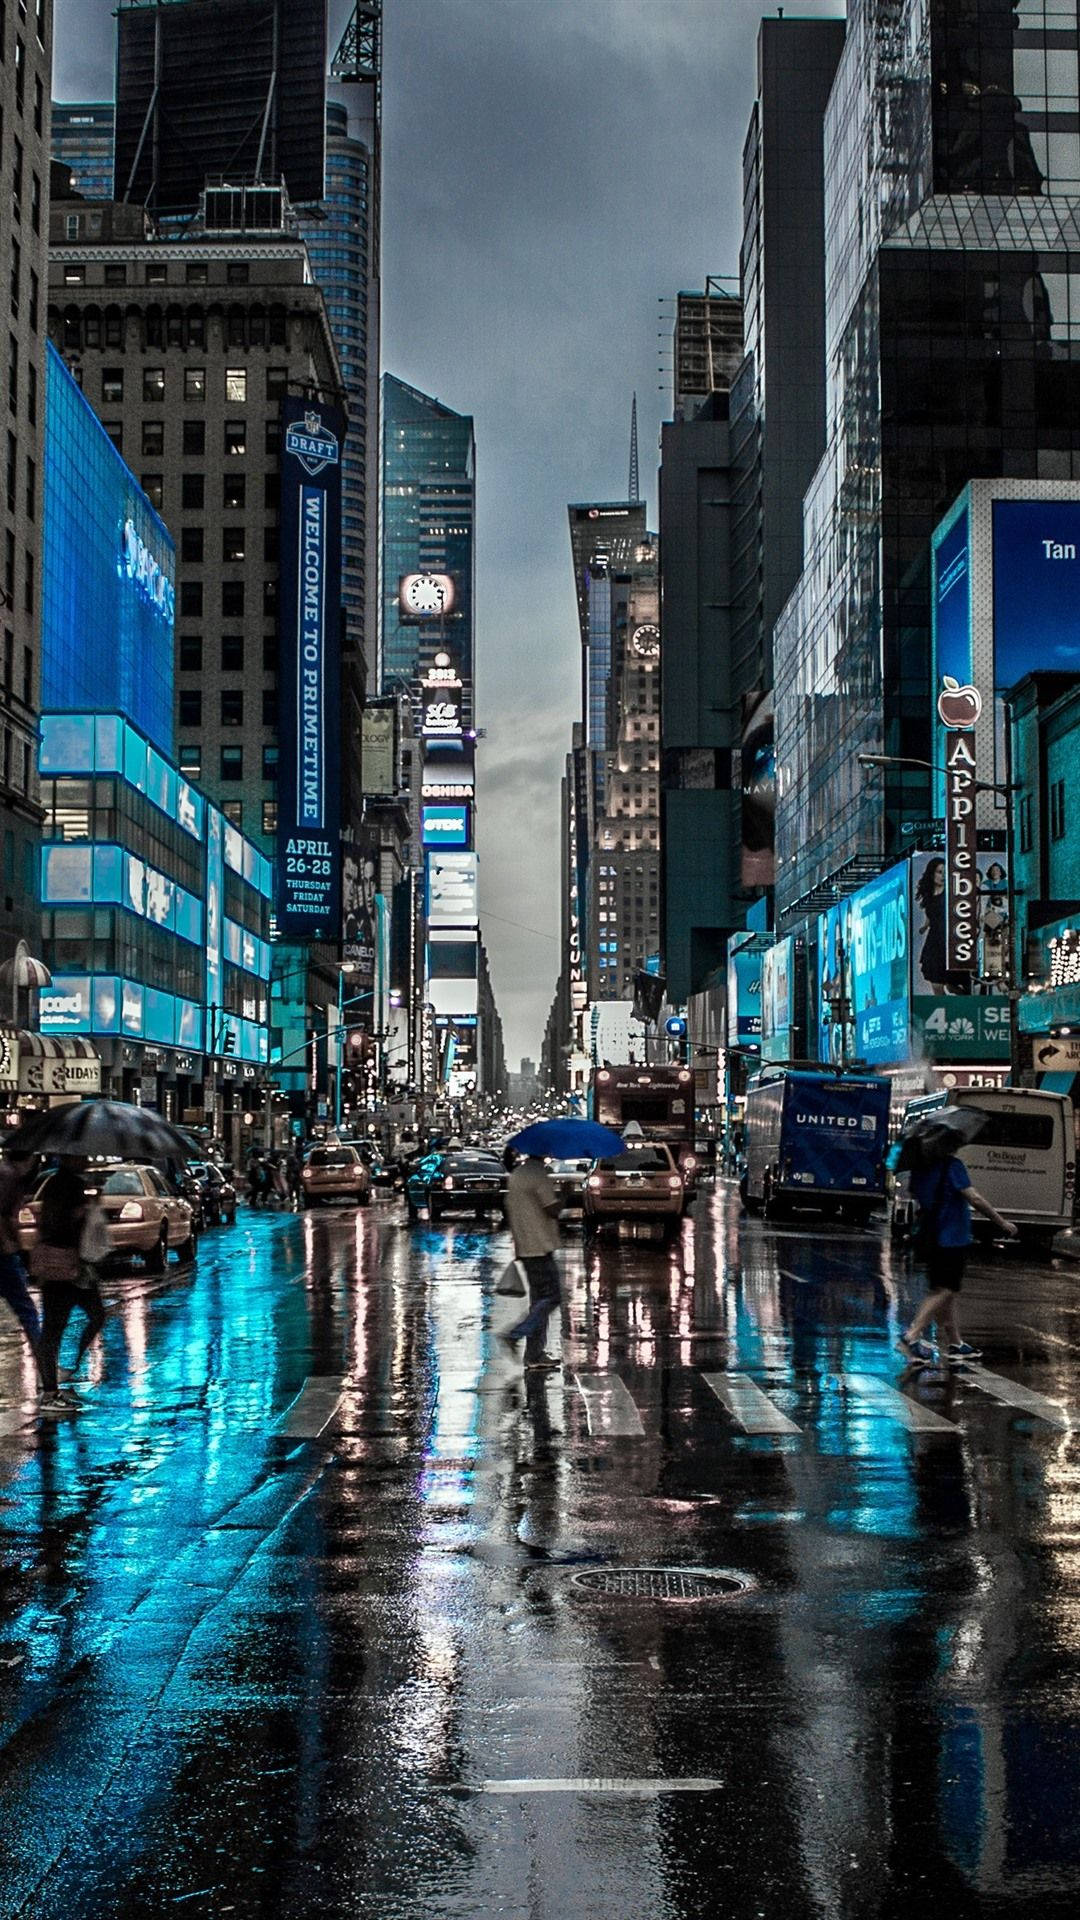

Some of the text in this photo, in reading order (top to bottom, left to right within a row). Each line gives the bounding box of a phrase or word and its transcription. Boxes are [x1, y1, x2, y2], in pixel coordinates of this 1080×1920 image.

[290, 435, 334, 456] DRAFT
[1042, 540, 1076, 559] Tan
[304, 497, 320, 818] WELCOME TO PRIMETIME
[286, 839, 332, 857] APRIL
[948, 739, 976, 961] Applebee's
[287, 858, 331, 875] 26-28
[286, 880, 332, 891] THURSDAY
[293, 892, 325, 902] FRIDAY
[286, 904, 331, 914] SATURDAY
[925, 1007, 948, 1034] 4
[984, 1029, 1011, 1041] WE
[796, 1114, 858, 1127] UNITED
